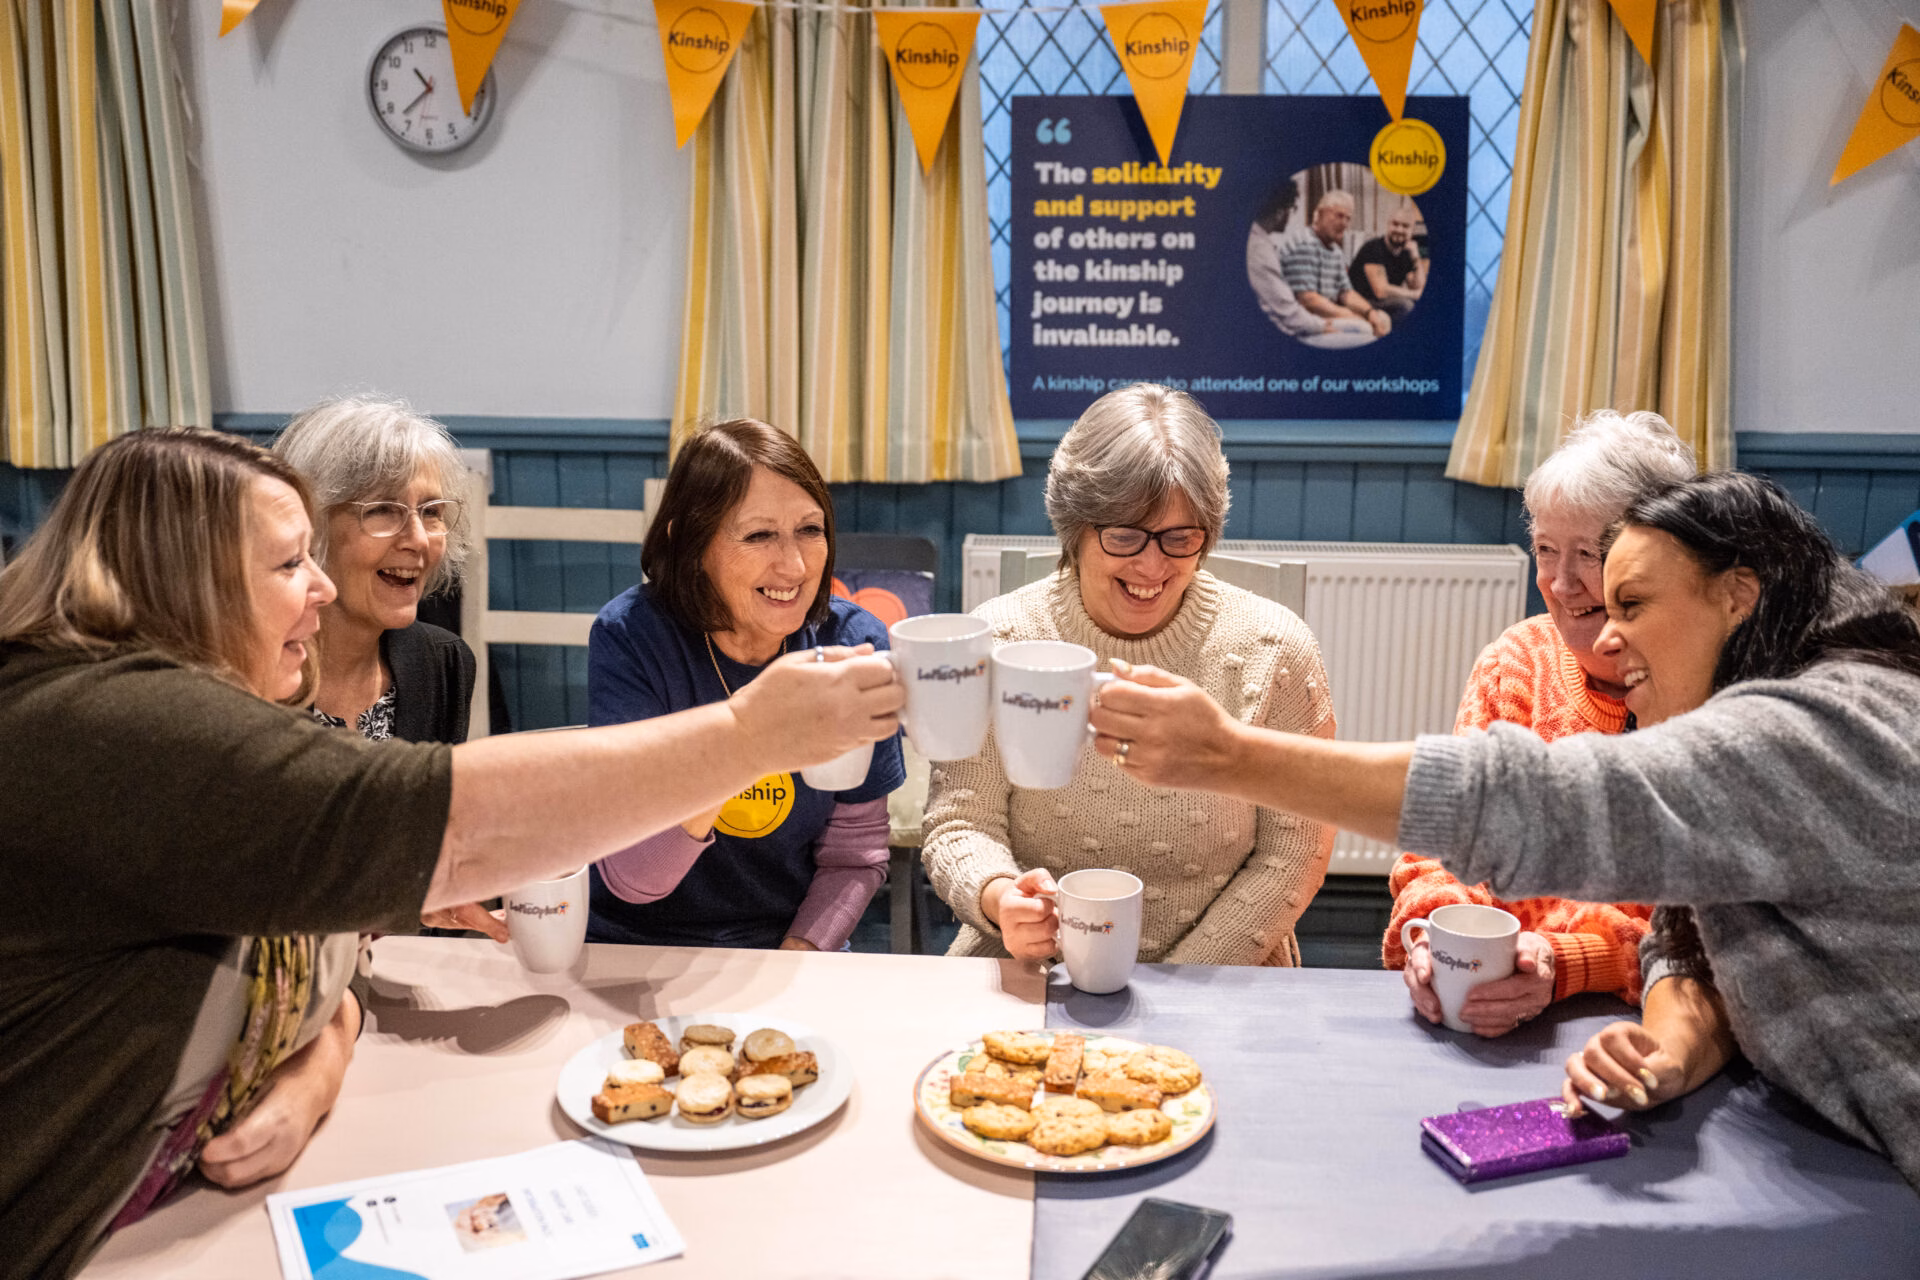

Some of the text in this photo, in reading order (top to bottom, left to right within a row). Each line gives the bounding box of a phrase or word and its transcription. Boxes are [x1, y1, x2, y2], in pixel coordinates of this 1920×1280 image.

[448, 0, 508, 19] nship
[1350, 0, 1416, 22] Kinship
[424, 35, 437, 49] 12
[668, 31, 730, 55] Kinship
[1125, 37, 1190, 57] Kinship
[387, 55, 402, 69] 10
[895, 47, 960, 69] Kinship
[1886, 66, 1920, 104] Kins
[1377, 150, 1439, 169] Kinship
[1034, 161, 1223, 189] The solidarity
[1034, 194, 1197, 222] and support
[1033, 226, 1196, 249] of others on
[1033, 259, 1184, 288] the kinship
[1030, 291, 1163, 320] journey is
[1032, 323, 1181, 347] invaluable.
[1032, 375, 1046, 392] A
[1048, 375, 1105, 394] kinship
[1190, 375, 1265, 392] attended
[1267, 378, 1299, 392] one
[1301, 375, 1320, 392] of
[1321, 379, 1349, 392] our
[1351, 376, 1440, 395] workshops
[733, 783, 786, 806] ship
